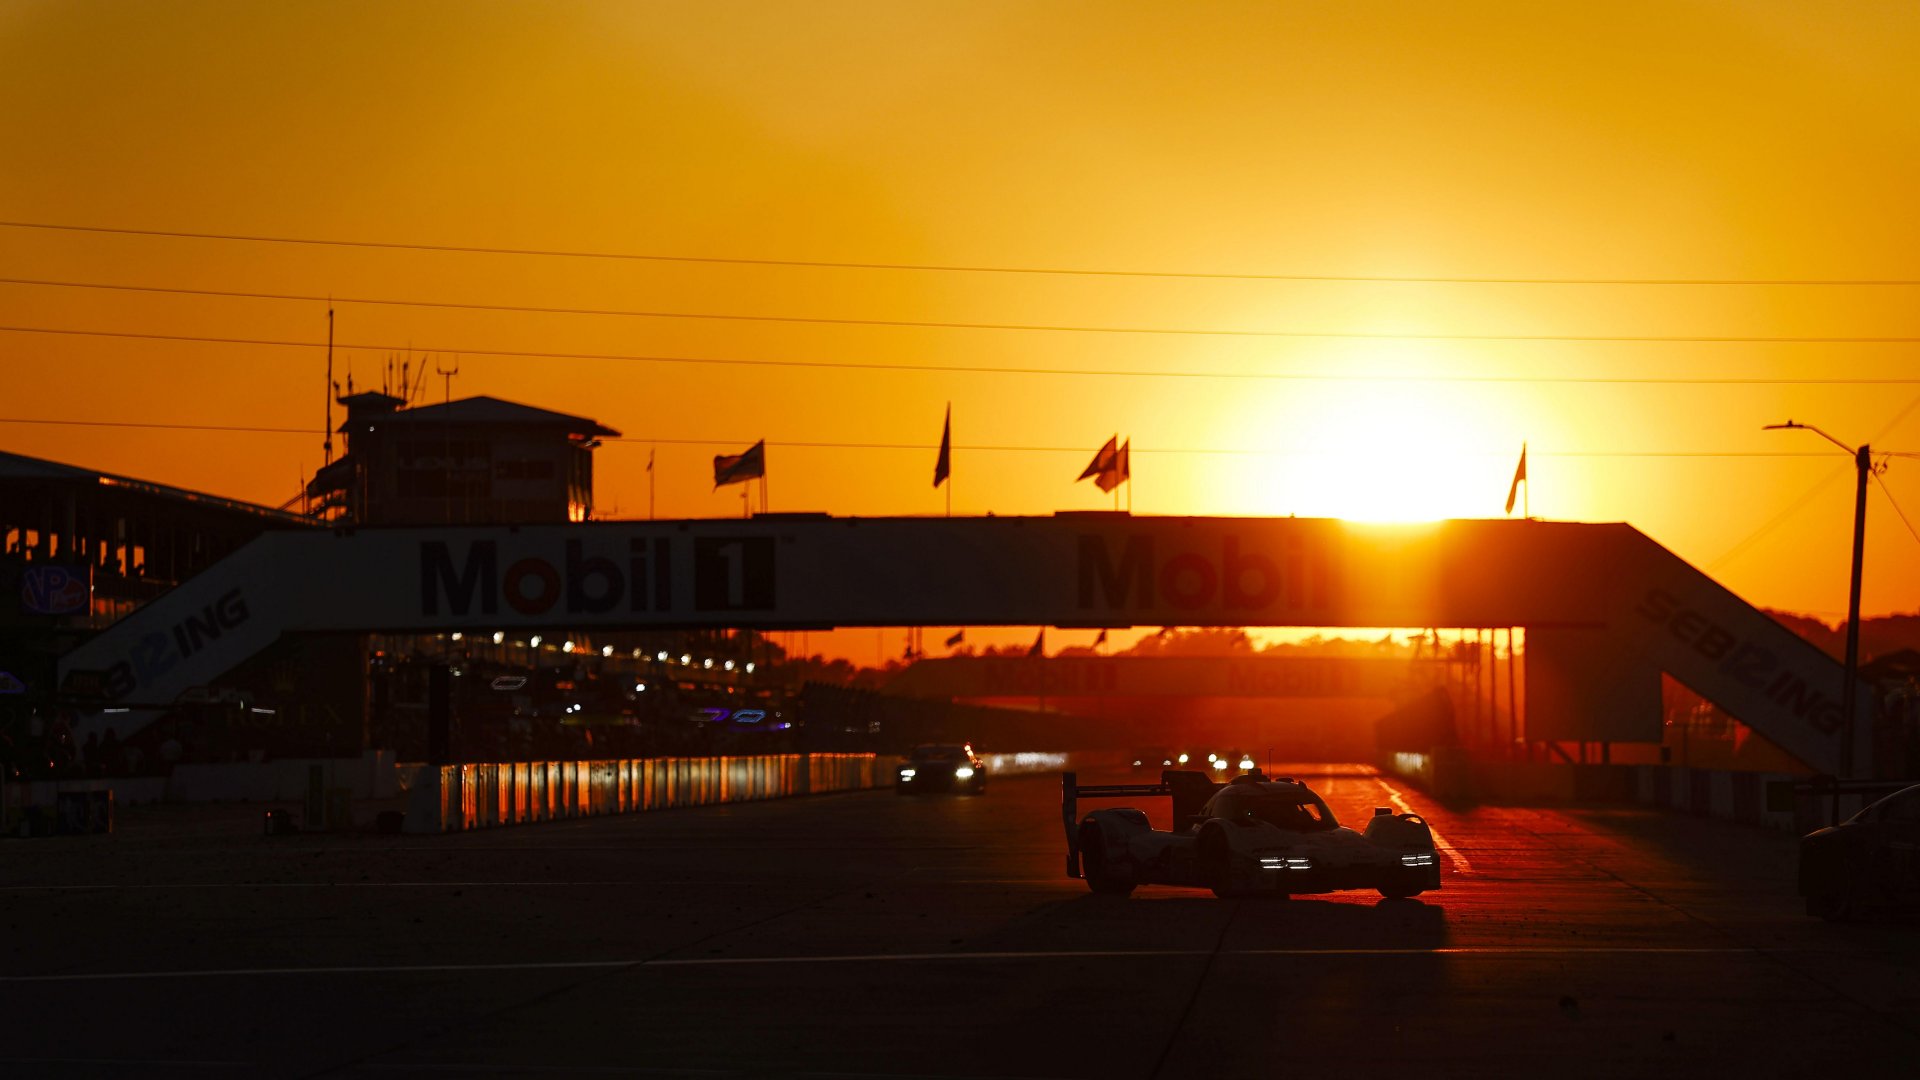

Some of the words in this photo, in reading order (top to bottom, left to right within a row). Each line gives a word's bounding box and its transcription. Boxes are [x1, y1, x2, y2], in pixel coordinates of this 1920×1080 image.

[24, 565, 69, 611] VP
[420, 538, 671, 616] Mobil
[1077, 534, 1328, 610] Mobil
